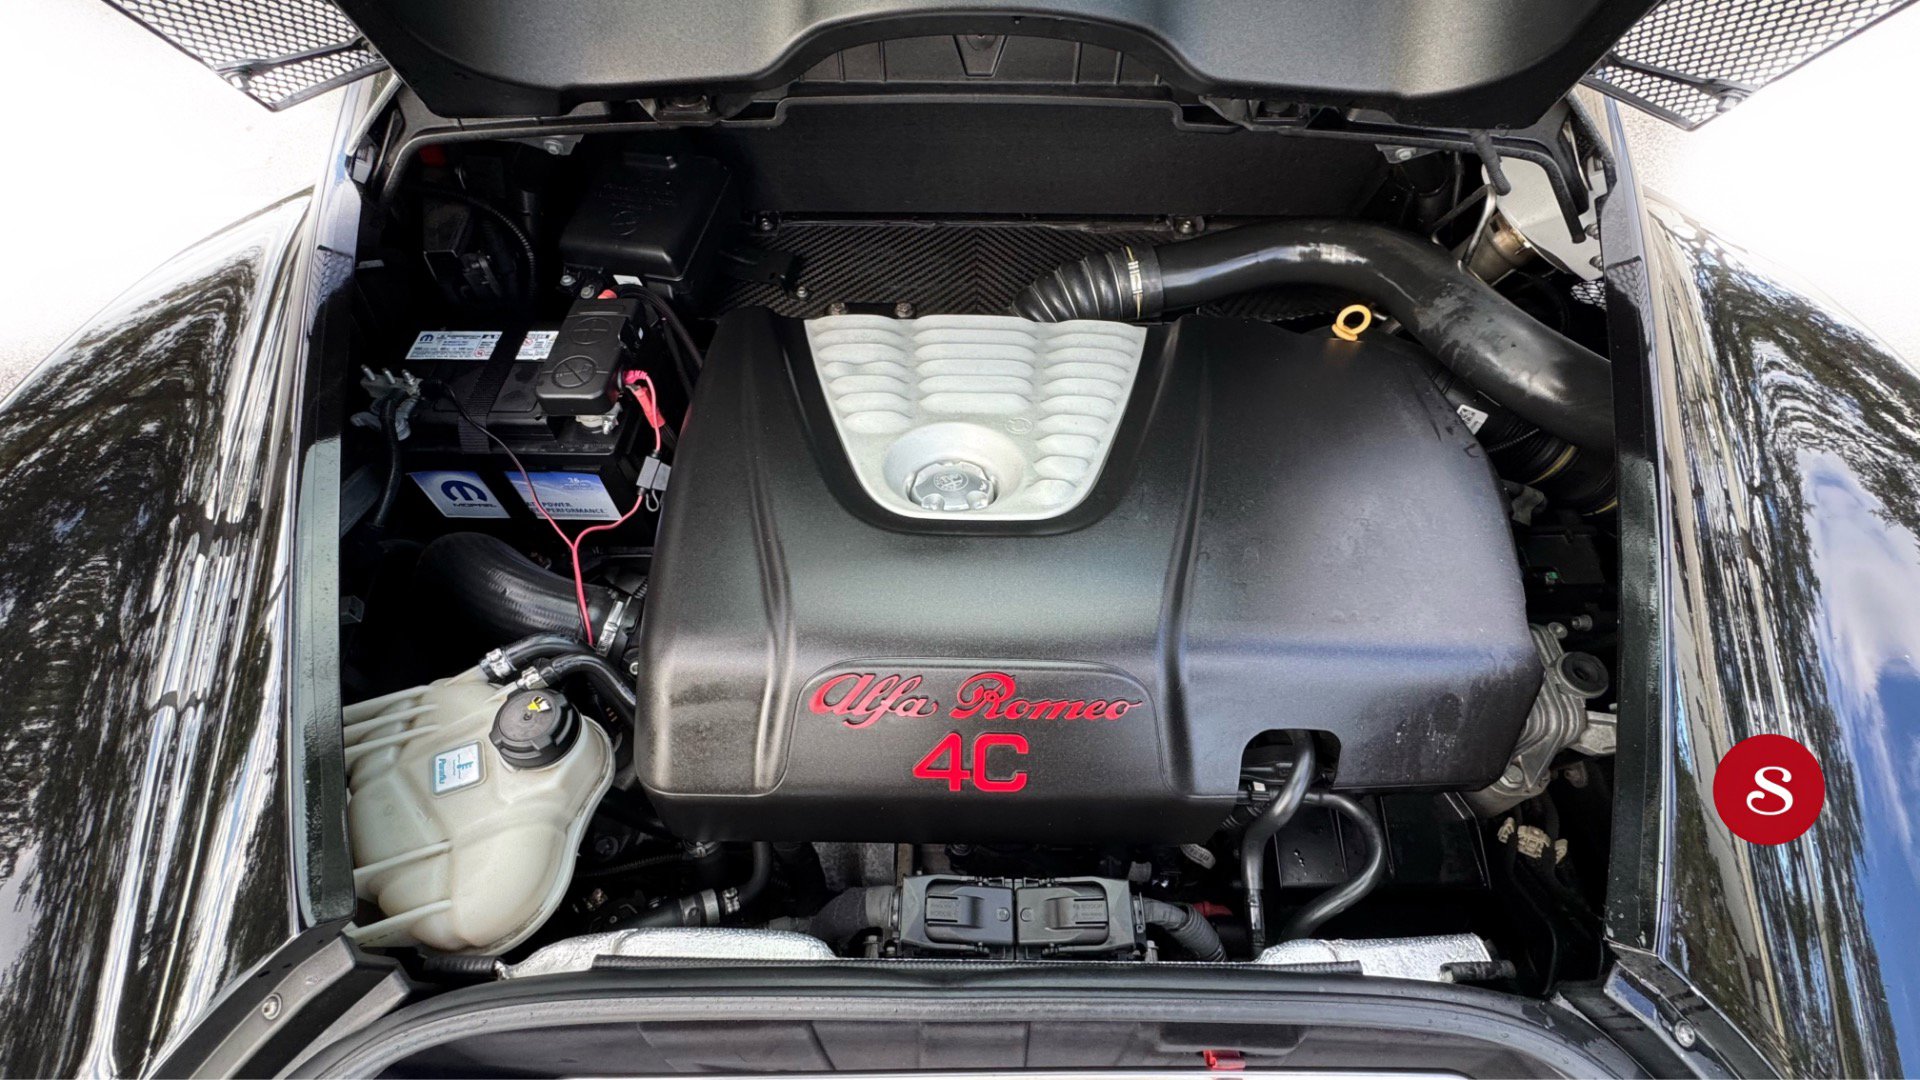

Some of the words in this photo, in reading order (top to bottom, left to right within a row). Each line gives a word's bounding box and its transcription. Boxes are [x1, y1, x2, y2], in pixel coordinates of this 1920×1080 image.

[808, 673, 938, 729] Alfa
[949, 671, 1142, 720] Romeo
[912, 731, 1030, 793] 4C
